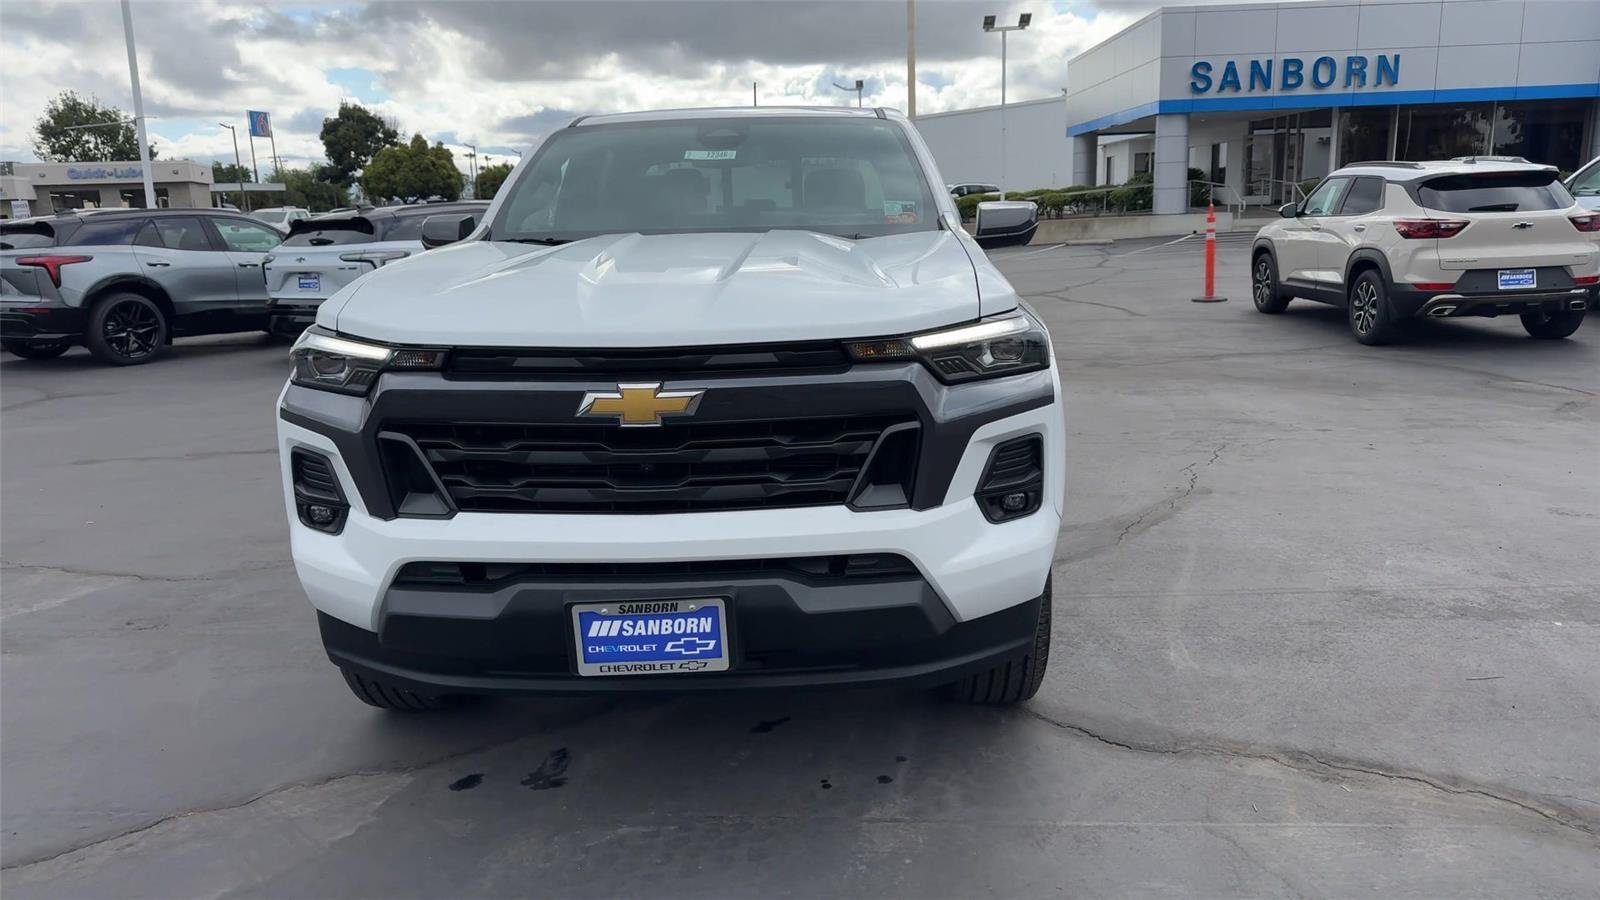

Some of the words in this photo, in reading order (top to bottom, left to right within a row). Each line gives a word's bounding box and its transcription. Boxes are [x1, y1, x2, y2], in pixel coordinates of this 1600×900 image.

[1190, 54, 1401, 93] SANBORN
[618, 602, 679, 614] SANBORN
[621, 617, 712, 637] SANBORN
[588, 644, 658, 653] CHEVROLET
[599, 662, 676, 673] CHEVROLET
